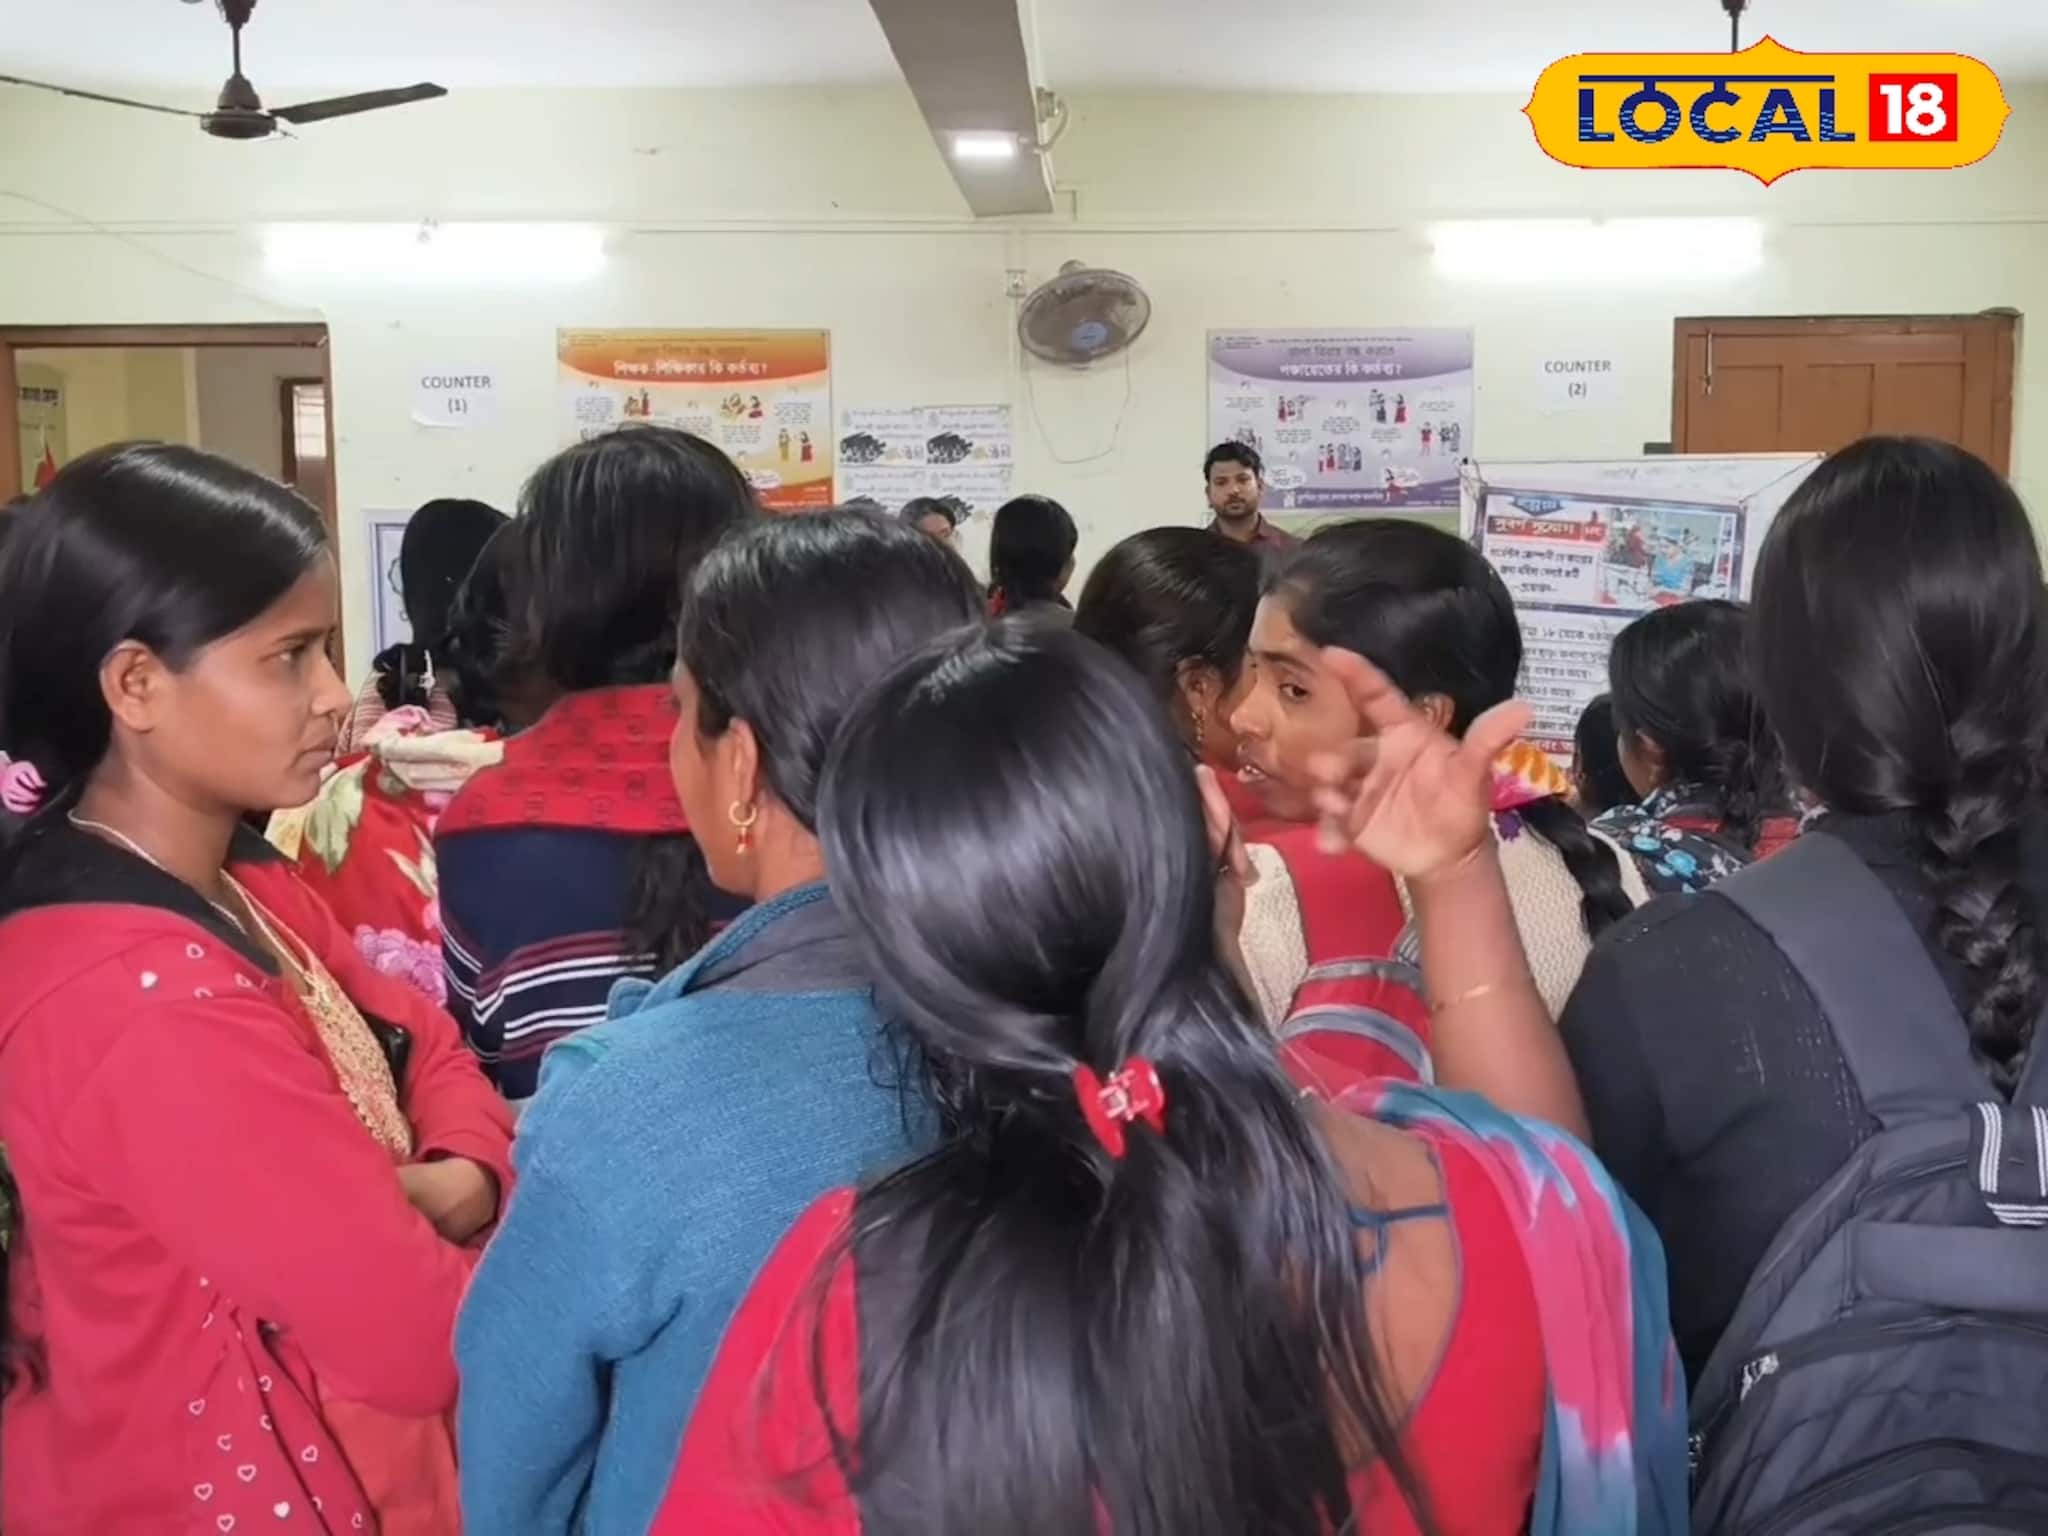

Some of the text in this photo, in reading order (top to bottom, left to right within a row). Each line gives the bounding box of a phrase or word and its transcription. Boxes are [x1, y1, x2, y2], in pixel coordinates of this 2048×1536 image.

[1544, 360, 1611, 373] COUNTER
[421, 376, 491, 388] COUNTER
[1568, 382, 1587, 398] (2)
[448, 397, 467, 413] (1)
